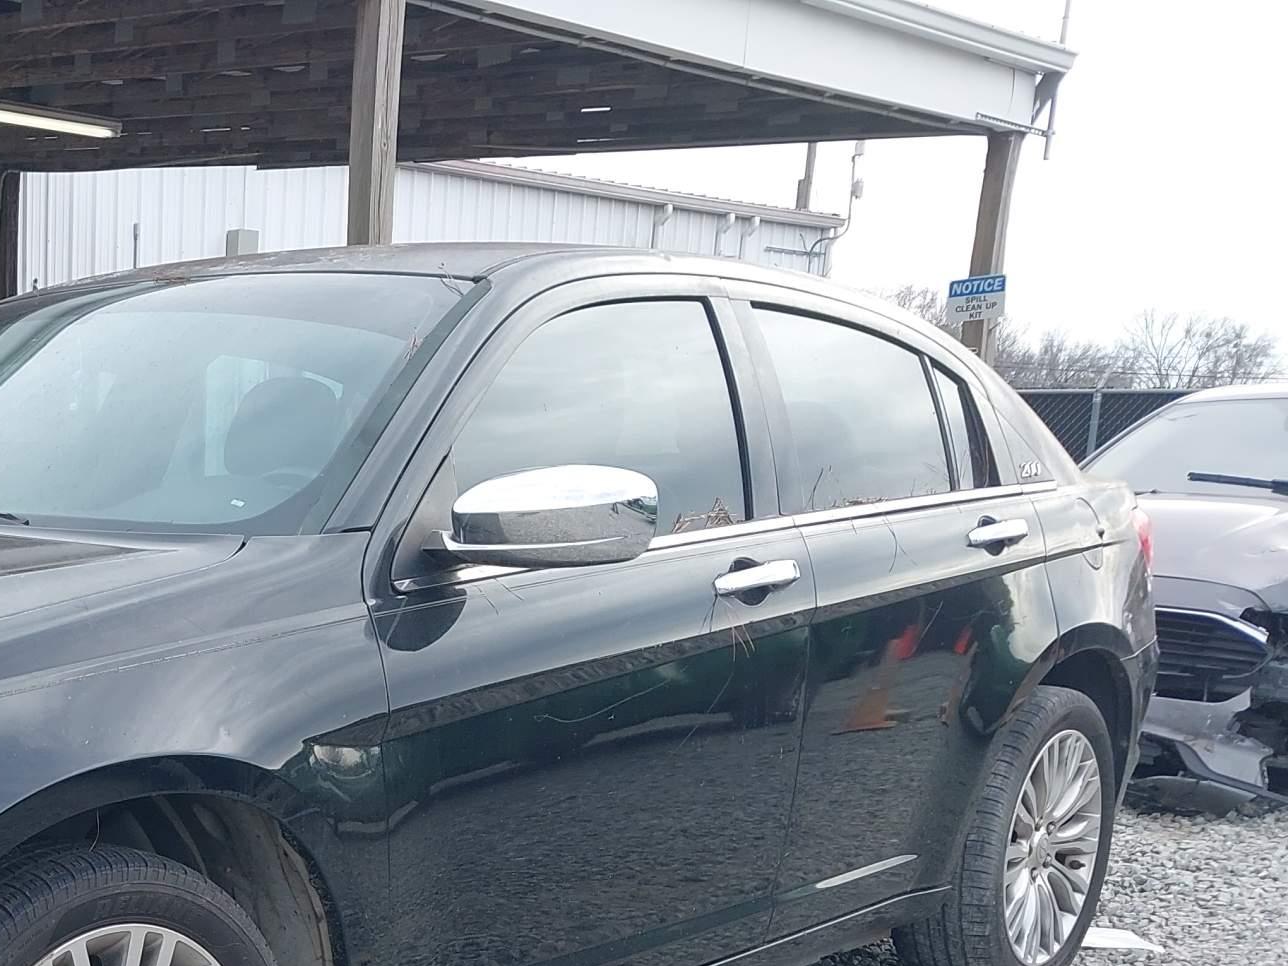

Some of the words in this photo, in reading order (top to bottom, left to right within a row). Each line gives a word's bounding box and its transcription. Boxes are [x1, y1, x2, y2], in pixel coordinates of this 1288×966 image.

[952, 278, 1004, 295] NOTICE
[966, 295, 988, 304] SPILL
[955, 304, 983, 313] CLEAN
[985, 301, 998, 310] UP
[968, 311, 983, 320] KIT
[1019, 461, 1041, 478] 200
